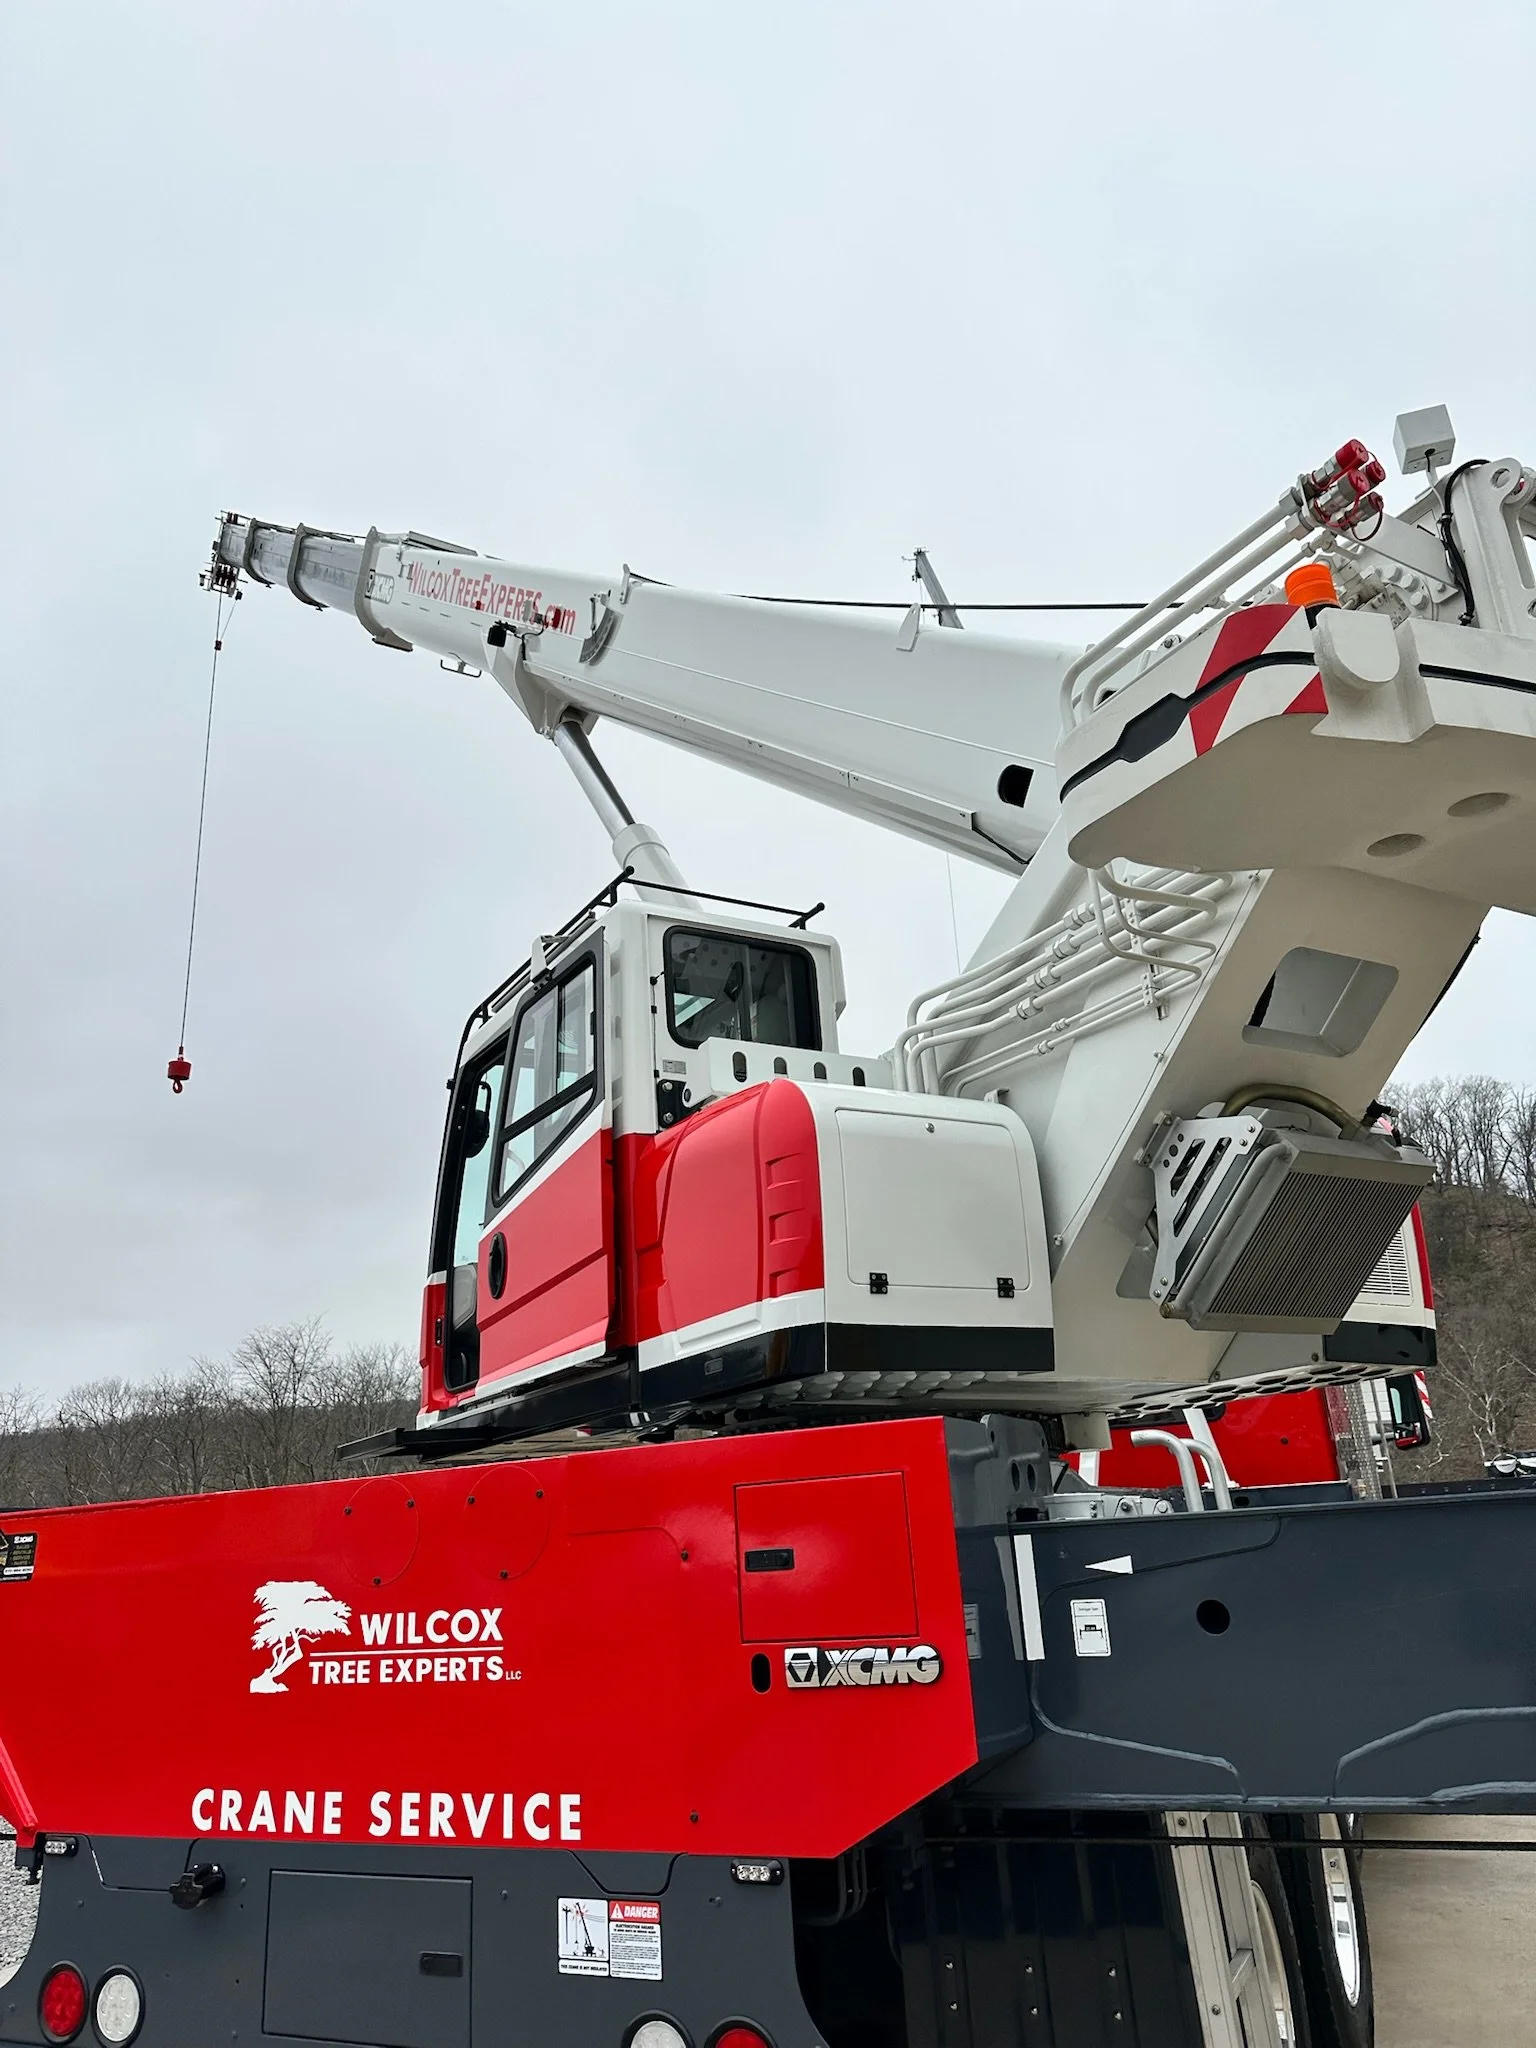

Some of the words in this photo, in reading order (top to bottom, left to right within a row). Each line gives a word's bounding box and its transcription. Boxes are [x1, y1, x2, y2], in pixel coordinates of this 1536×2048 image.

[408, 561, 577, 634] WILCOXTREEEXPERTScm
[360, 1608, 503, 1645] WILCOX
[308, 1659, 371, 1685] TREE
[379, 1655, 504, 1683] EXPERTS
[506, 1671, 522, 1681] LLC
[821, 1644, 940, 1686] XCMG
[192, 1788, 343, 1835] CRANE
[368, 1790, 582, 1841] SERVICE
[623, 1905, 659, 1919] DANGER
